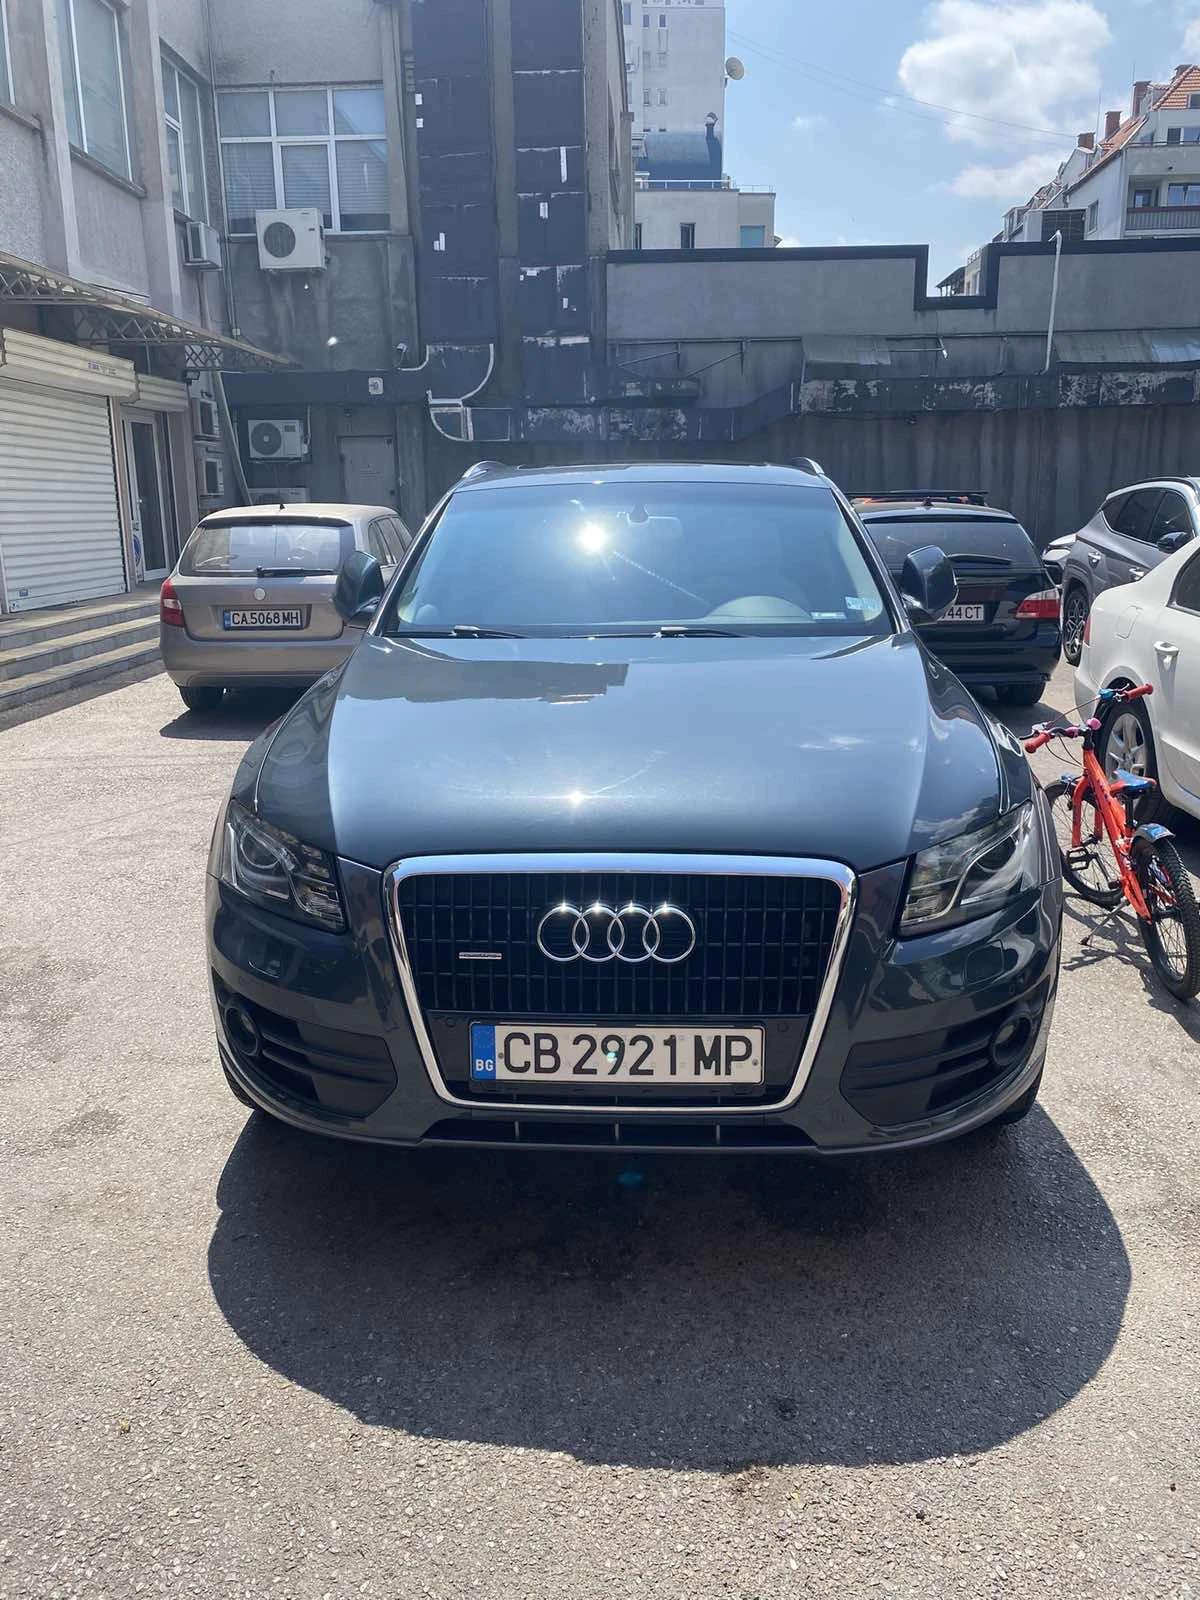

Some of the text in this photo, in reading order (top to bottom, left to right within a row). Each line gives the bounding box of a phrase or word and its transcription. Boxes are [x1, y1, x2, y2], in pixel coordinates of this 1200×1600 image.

[232, 611, 299, 625] CA 5068 MH
[942, 606, 981, 619] 44 CT
[503, 1032, 753, 1076] CB 2921 MP
[475, 1059, 494, 1071] BG
